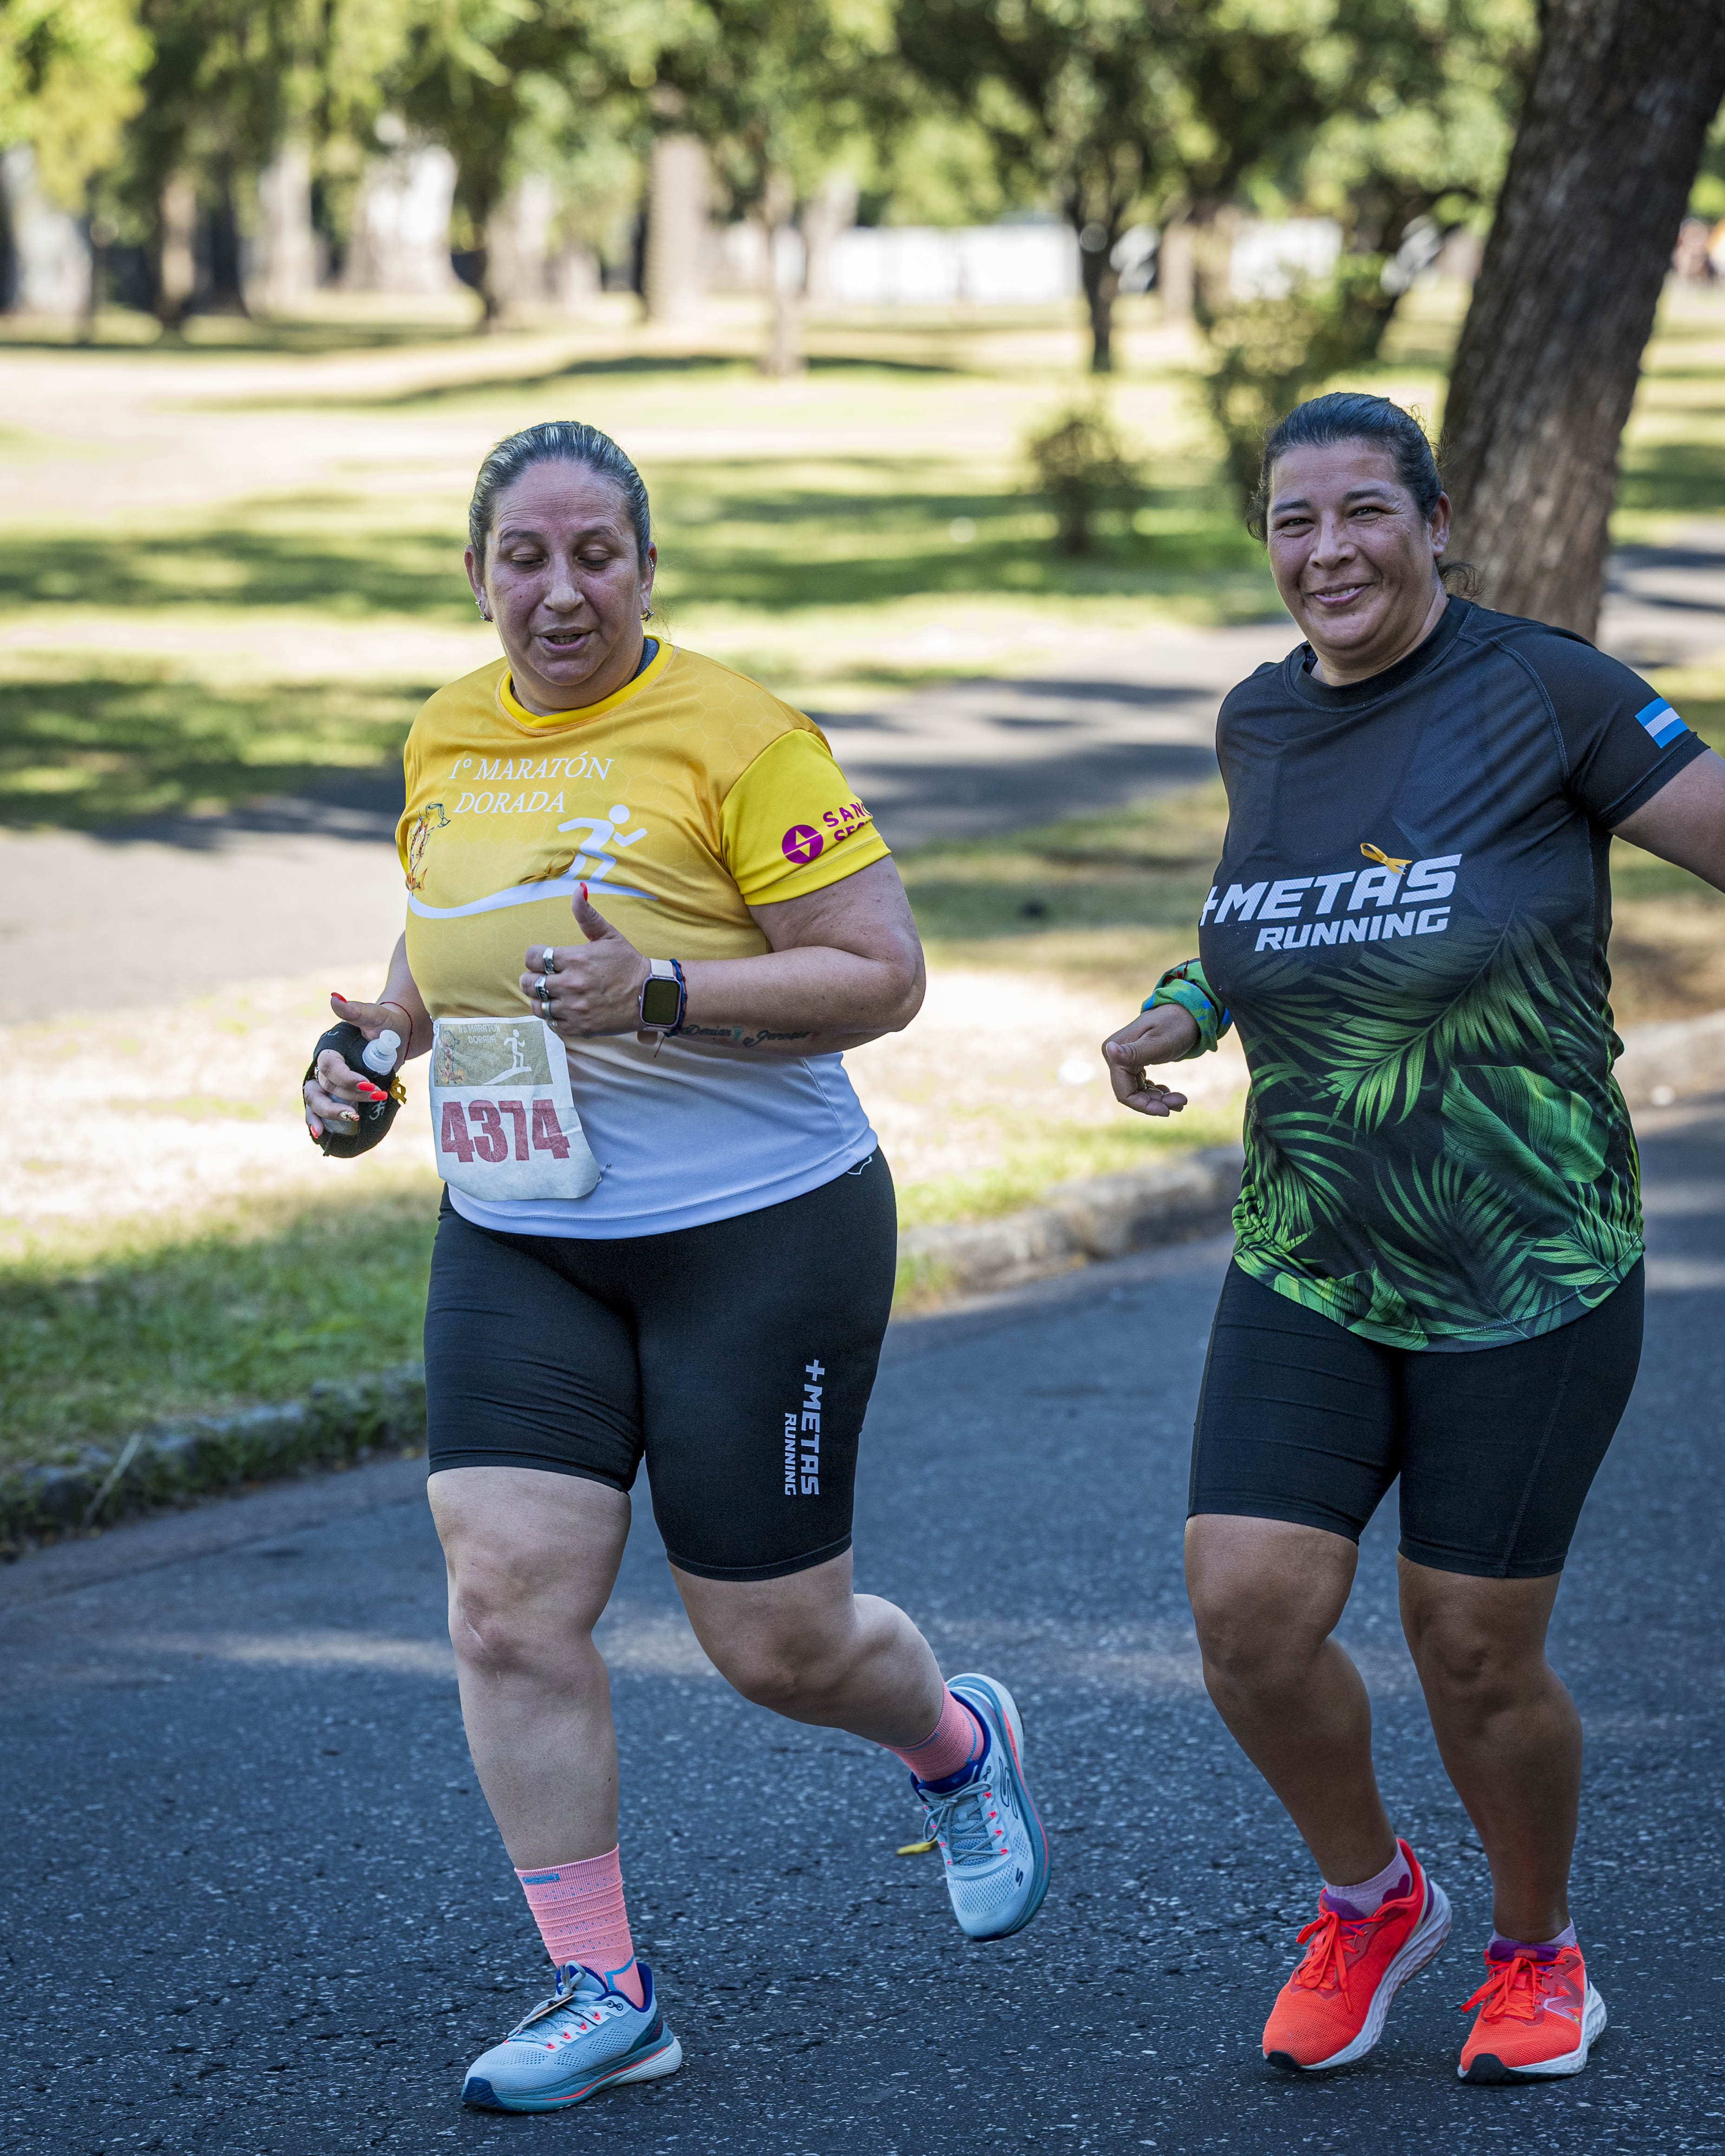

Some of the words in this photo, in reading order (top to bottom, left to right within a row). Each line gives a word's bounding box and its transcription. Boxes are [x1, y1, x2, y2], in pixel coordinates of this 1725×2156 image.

[473, 751, 614, 780] MARATÓN
[453, 791, 565, 813] DORADA
[1255, 906, 1451, 951] RUNNING
[468, 1035, 496, 1043] DORADA
[441, 1100, 570, 1162] 4374
[784, 1413, 797, 1495] RUNNING
